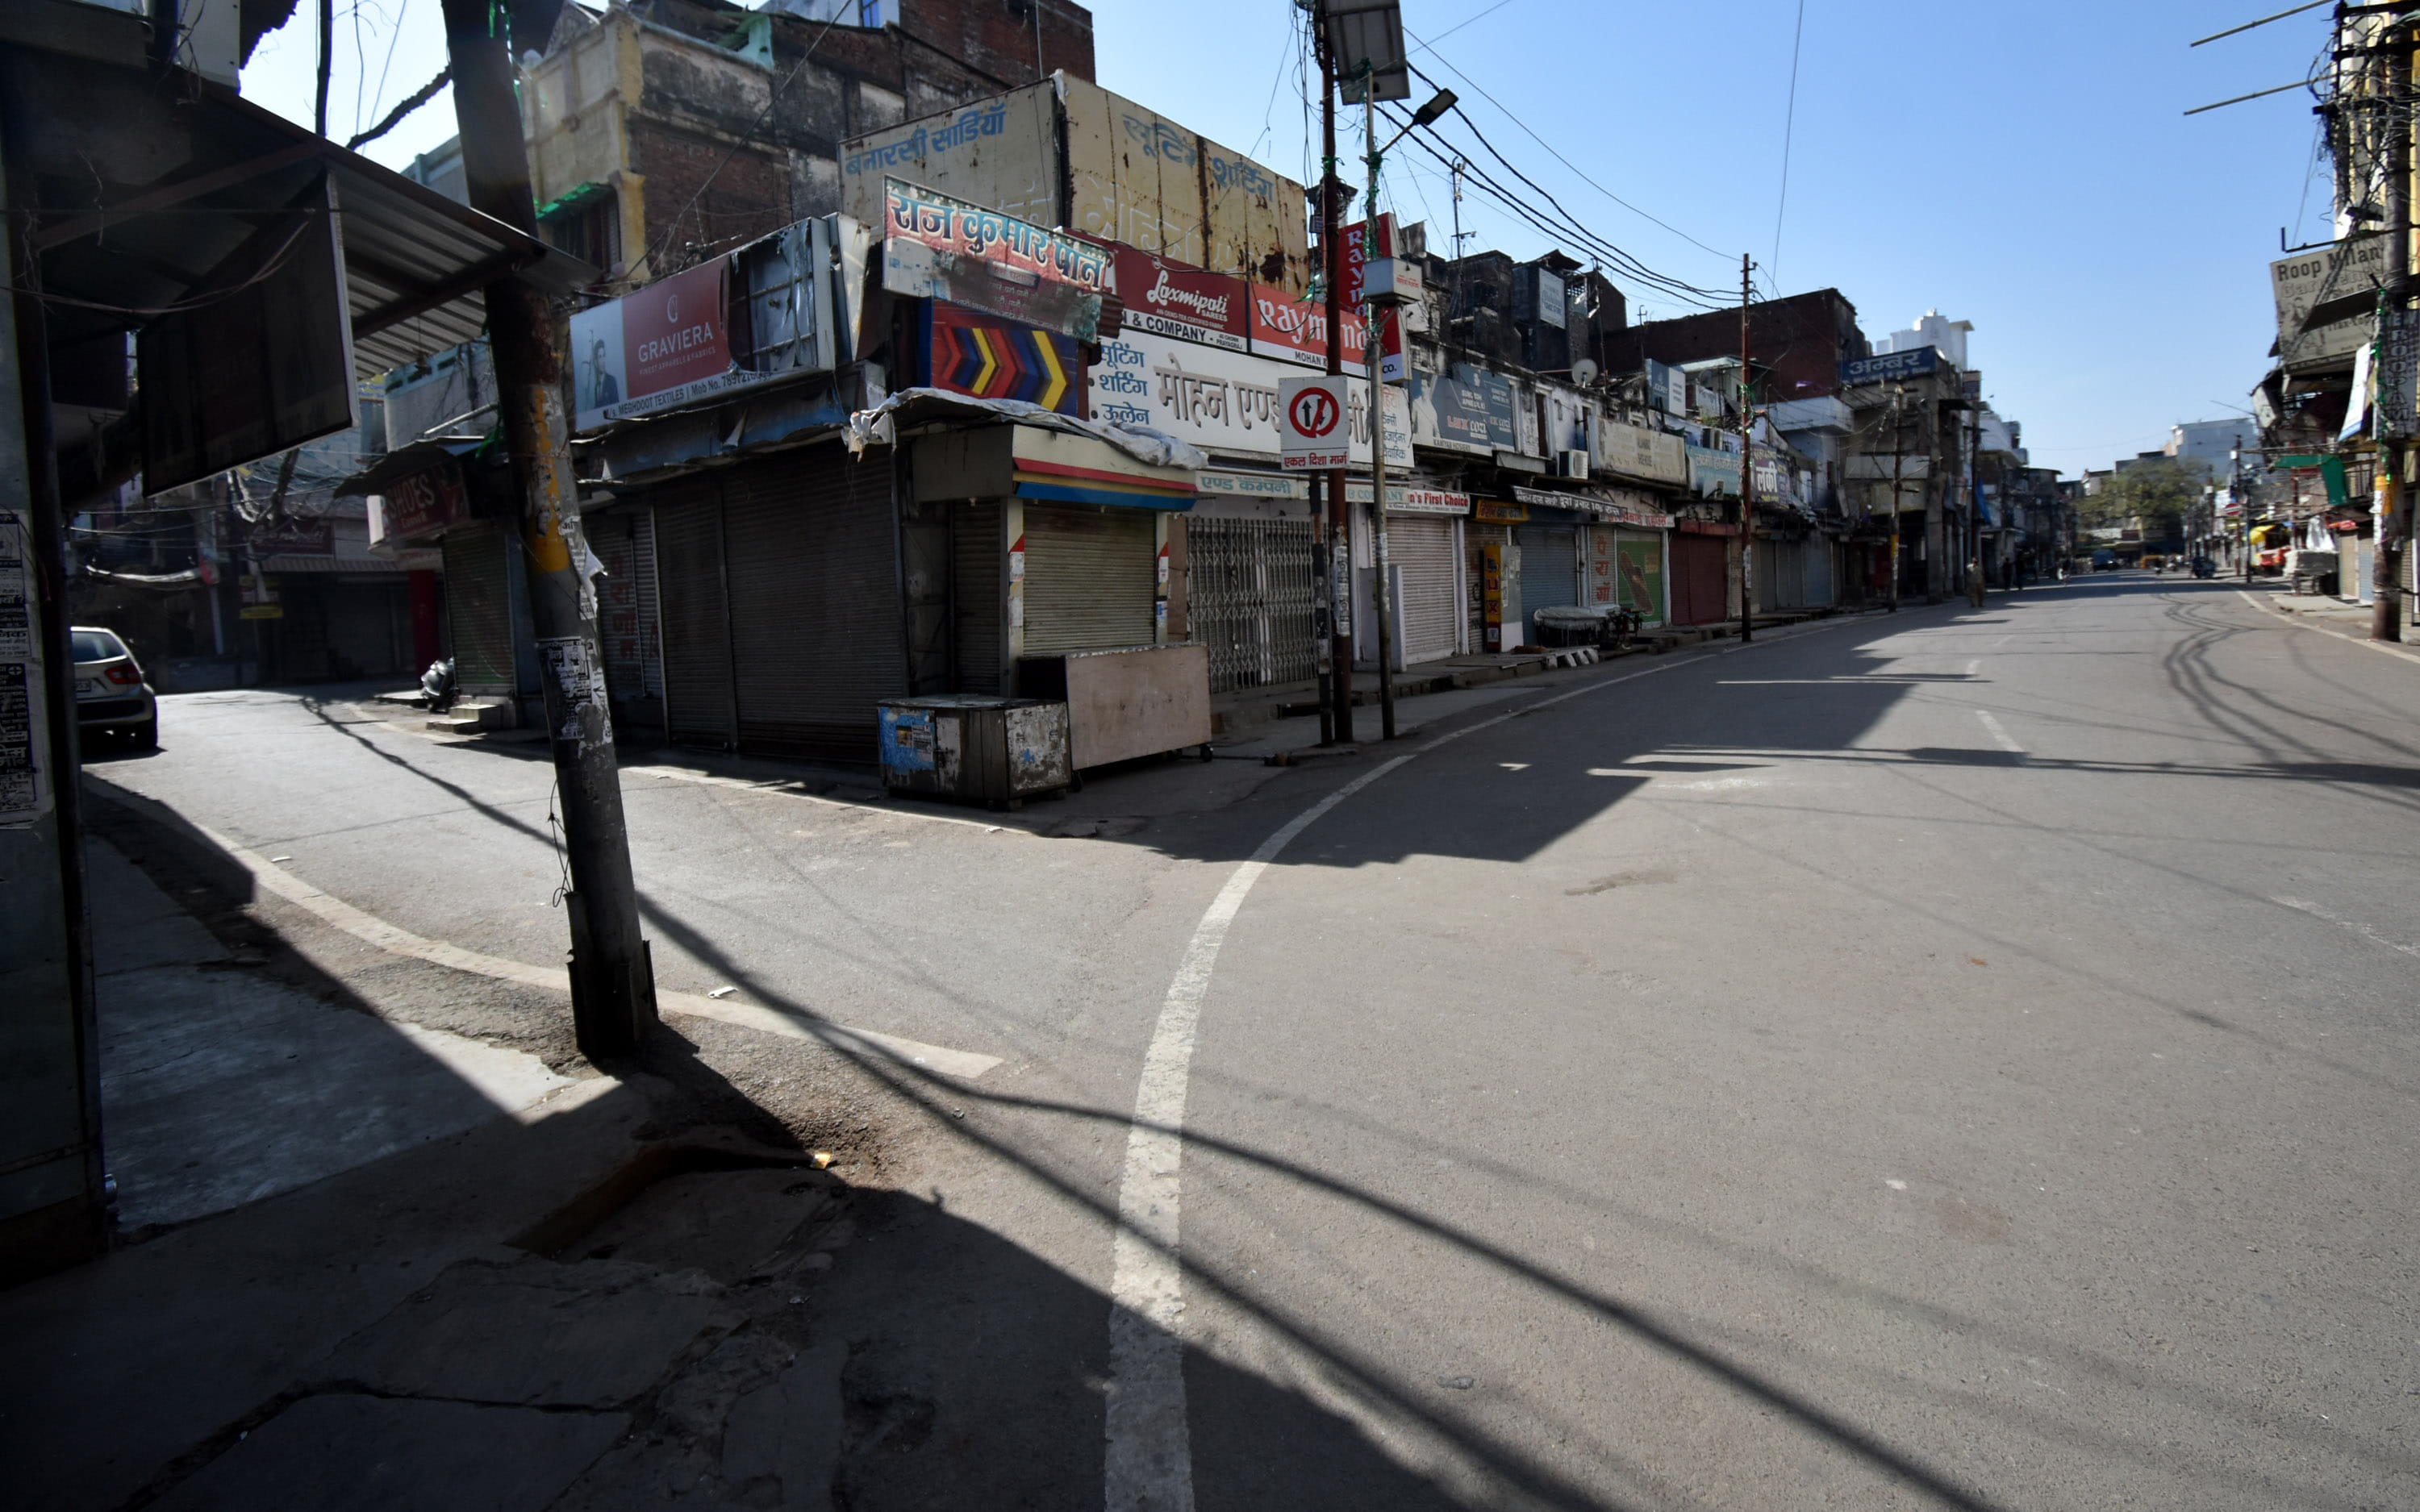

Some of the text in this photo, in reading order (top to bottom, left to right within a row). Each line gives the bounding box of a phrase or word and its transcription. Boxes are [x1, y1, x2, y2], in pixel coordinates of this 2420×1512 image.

[845, 127, 927, 175] बनारसी
[887, 190, 955, 242] राज
[958, 206, 1051, 268] कुमार
[1051, 237, 1108, 293] पान
[2276, 259, 2322, 282] Roop
[1146, 269, 1229, 314] Laxmipati
[1133, 313, 1142, 327] &
[1145, 315, 1207, 342] COMPANY
[1201, 309, 1229, 323] SAREES
[1257, 298, 1369, 351] Raymnd
[637, 320, 715, 363] GRAVIERA
[1100, 344, 1145, 369] सूटिंग
[1294, 352, 1322, 364] MOHAN
[1382, 364, 1397, 374] CO.
[1848, 350, 1922, 376] अम्बर
[618, 395, 653, 415] MEGHDOOT
[654, 387, 684, 406] TEXTILES
[691, 382, 707, 396] Mob
[707, 379, 721, 393] No.
[1098, 369, 1149, 398] शर्टिंग
[1153, 352, 1229, 428] मोहन
[1283, 449, 1348, 468] एकल दिशा मार्ग
[387, 472, 436, 519] SHOES
[1200, 475, 1235, 491] एण्ड
[1238, 476, 1292, 494] कम्पनी
[1357, 489, 1405, 502] COANY
[1424, 492, 1443, 505] First
[1444, 493, 1469, 507] Choice
